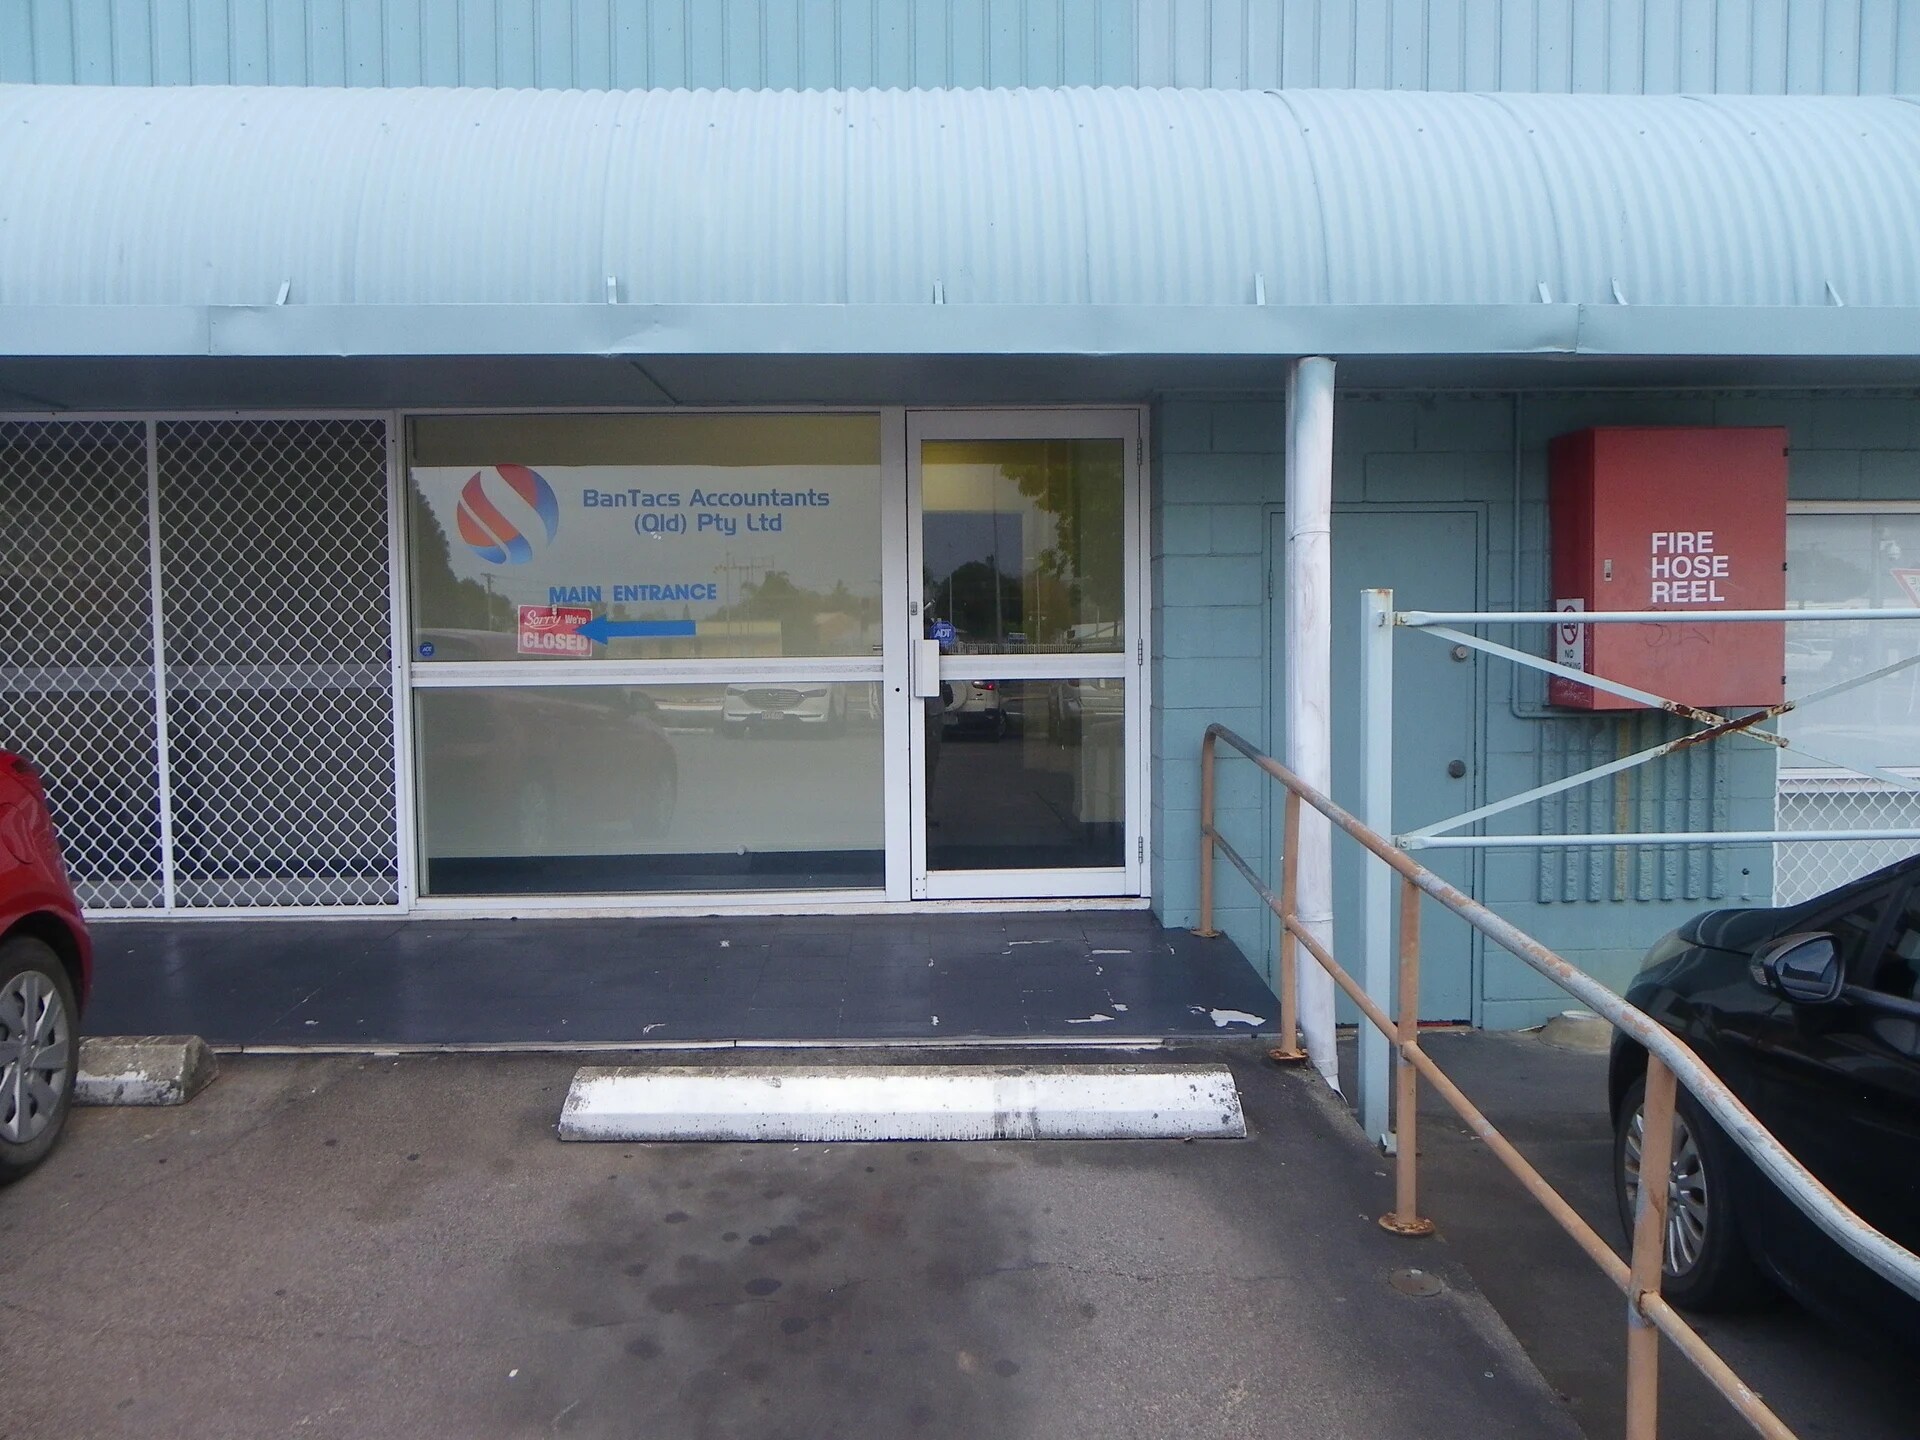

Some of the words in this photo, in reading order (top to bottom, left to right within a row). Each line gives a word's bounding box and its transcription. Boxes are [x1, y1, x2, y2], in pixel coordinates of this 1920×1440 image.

[583, 489, 680, 507] BanTacs
[690, 488, 830, 507] Accountants
[634, 513, 687, 535] (Qld)
[697, 513, 737, 536] Pty
[747, 513, 782, 532] Ltd
[1652, 531, 1714, 554] FIRE
[1652, 555, 1729, 578] HOSE
[549, 585, 602, 604] MAIN
[613, 583, 717, 601] ENTRANCE
[1652, 580, 1725, 603] REEL
[524, 609, 562, 630] Sorry
[565, 614, 587, 625] We're
[522, 631, 588, 651] CLOSED
[934, 628, 952, 638] ADT
[1564, 648, 1575, 659] NO
